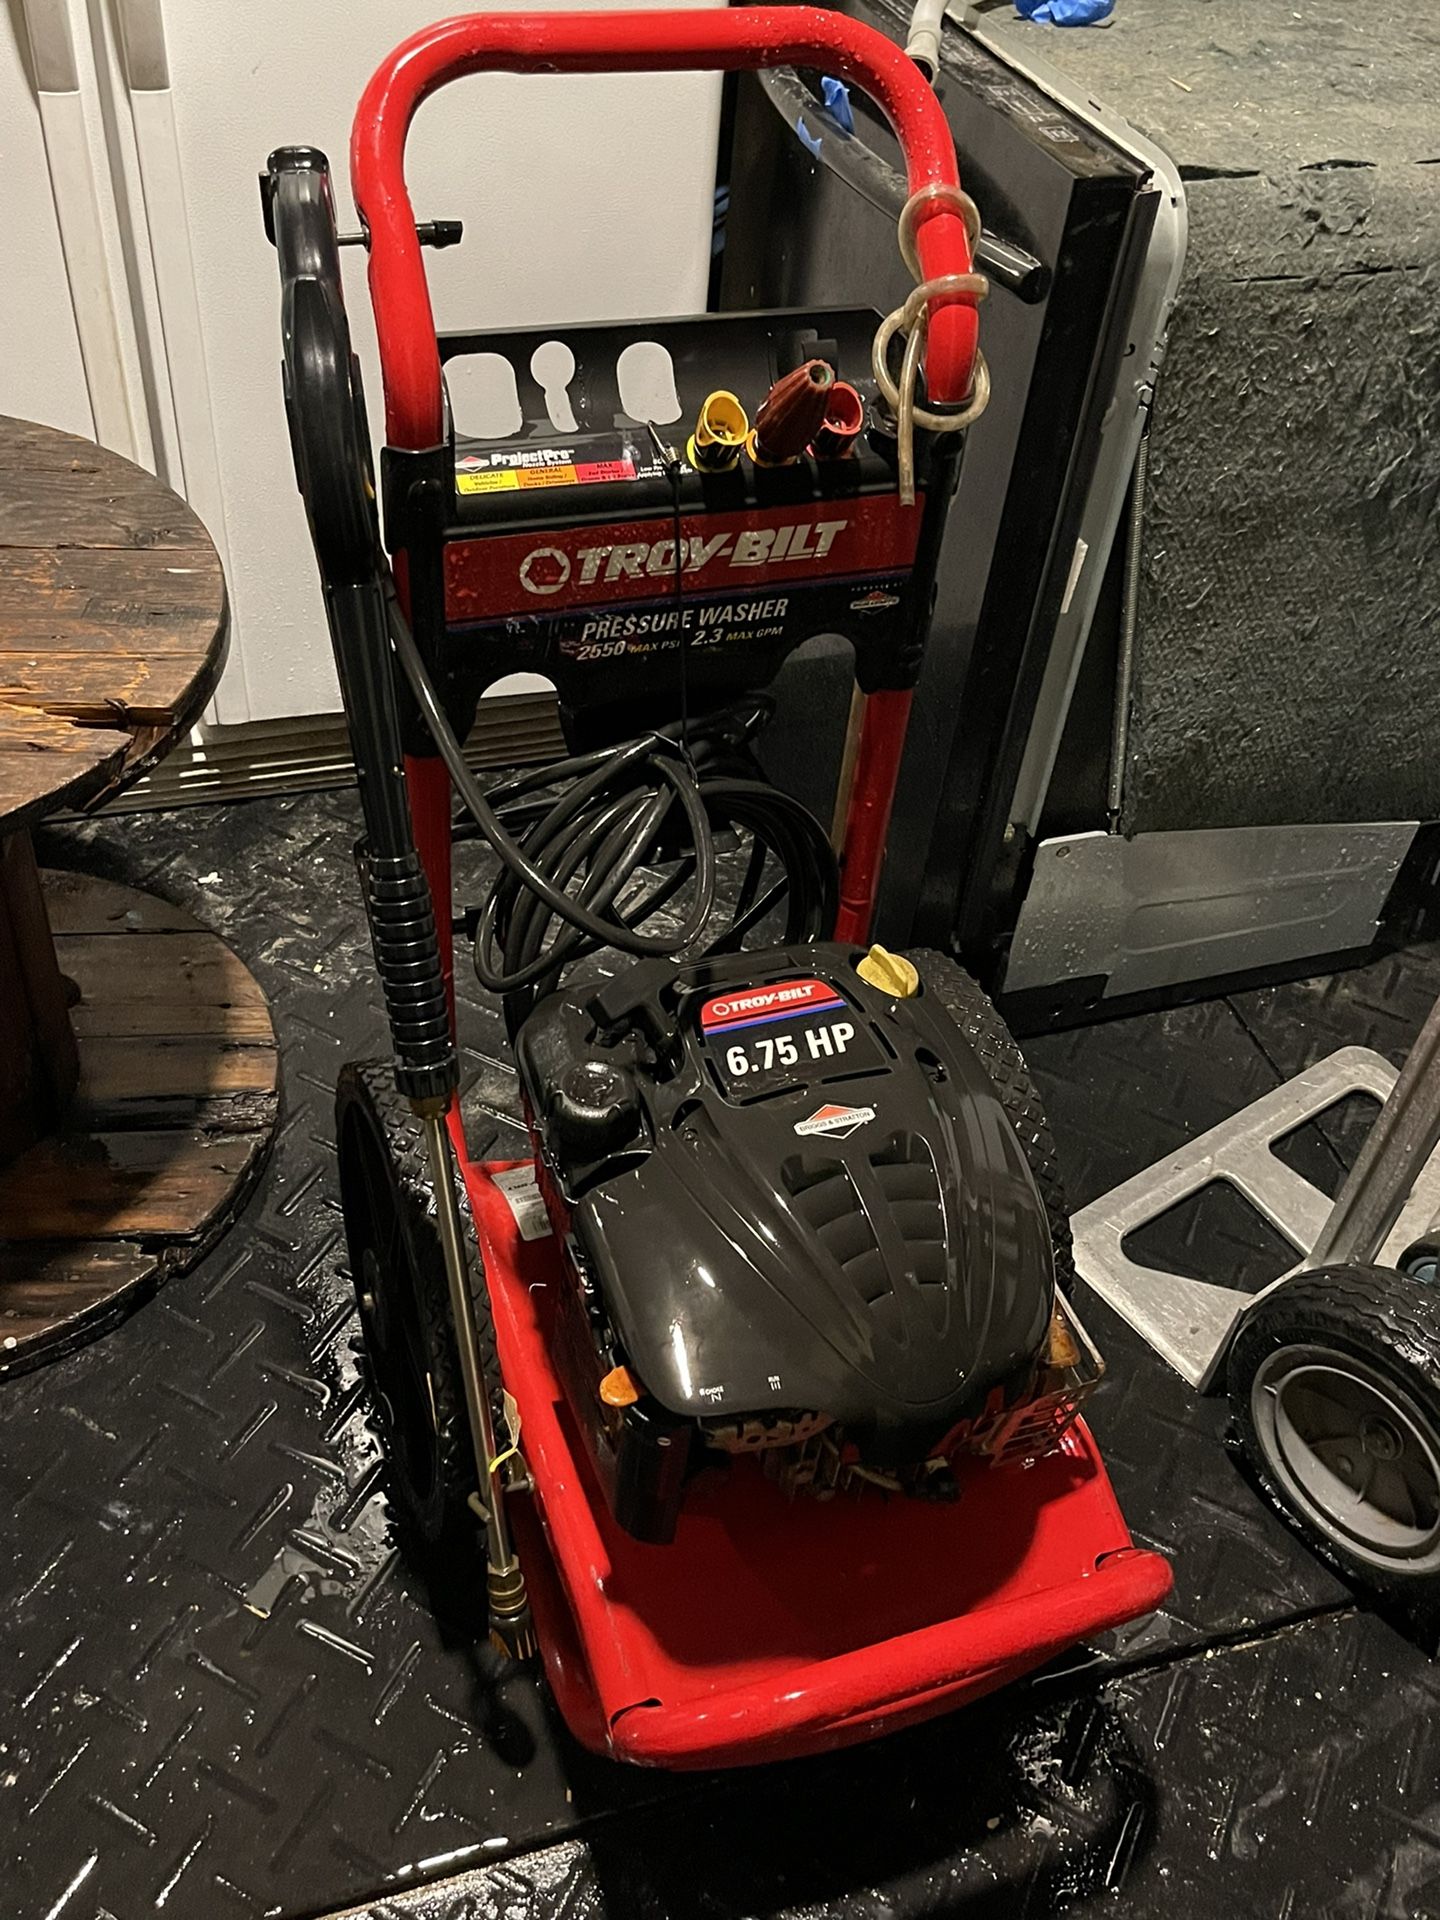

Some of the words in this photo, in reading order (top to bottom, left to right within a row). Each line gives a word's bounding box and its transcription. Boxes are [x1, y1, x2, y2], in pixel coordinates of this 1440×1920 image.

[469, 472, 504, 480] DELICATE
[529, 467, 562, 475] GENERAL
[576, 520, 848, 585] TROY-BILT
[581, 609, 694, 642] PRESSURE
[699, 598, 790, 626] WASHER
[576, 640, 627, 660] 2550
[629, 642, 659, 653] MAX
[661, 640, 680, 650] PSI
[690, 628, 724, 646] 2.3
[726, 630, 754, 641] MAX
[756, 626, 783, 638] GPM
[729, 985, 815, 1012] TROY-BILT
[726, 1035, 799, 1077] 6.75
[804, 1022, 855, 1060] HP
[799, 1121, 827, 1132] BRIGGS
[834, 1111, 871, 1124] STRATTON
